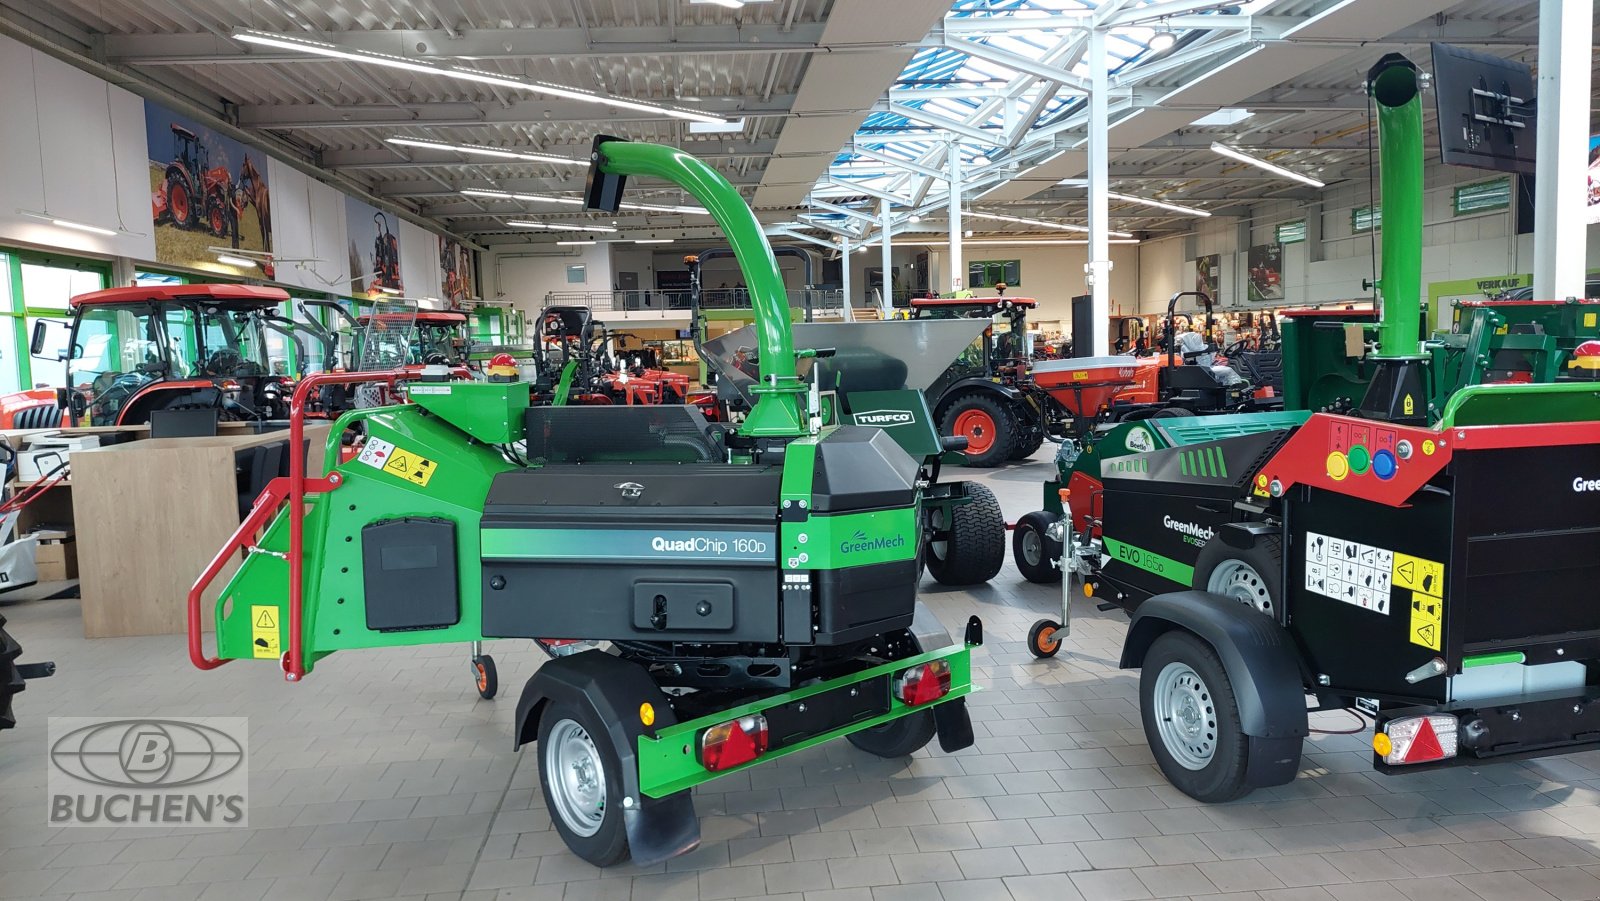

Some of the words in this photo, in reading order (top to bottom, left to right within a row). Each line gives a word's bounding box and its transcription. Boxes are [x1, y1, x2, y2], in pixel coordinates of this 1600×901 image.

[1477, 278, 1520, 290] VERKAUF
[859, 413, 910, 423] TURFCO
[1130, 441, 1147, 451] Beetle
[1163, 514, 1215, 540] GreenMech
[651, 536, 728, 555] QuadChip
[732, 538, 767, 553] 160D
[840, 533, 905, 554] GreenMech
[1183, 534, 1206, 548] EVOSER
[1119, 544, 1140, 564] EVO
